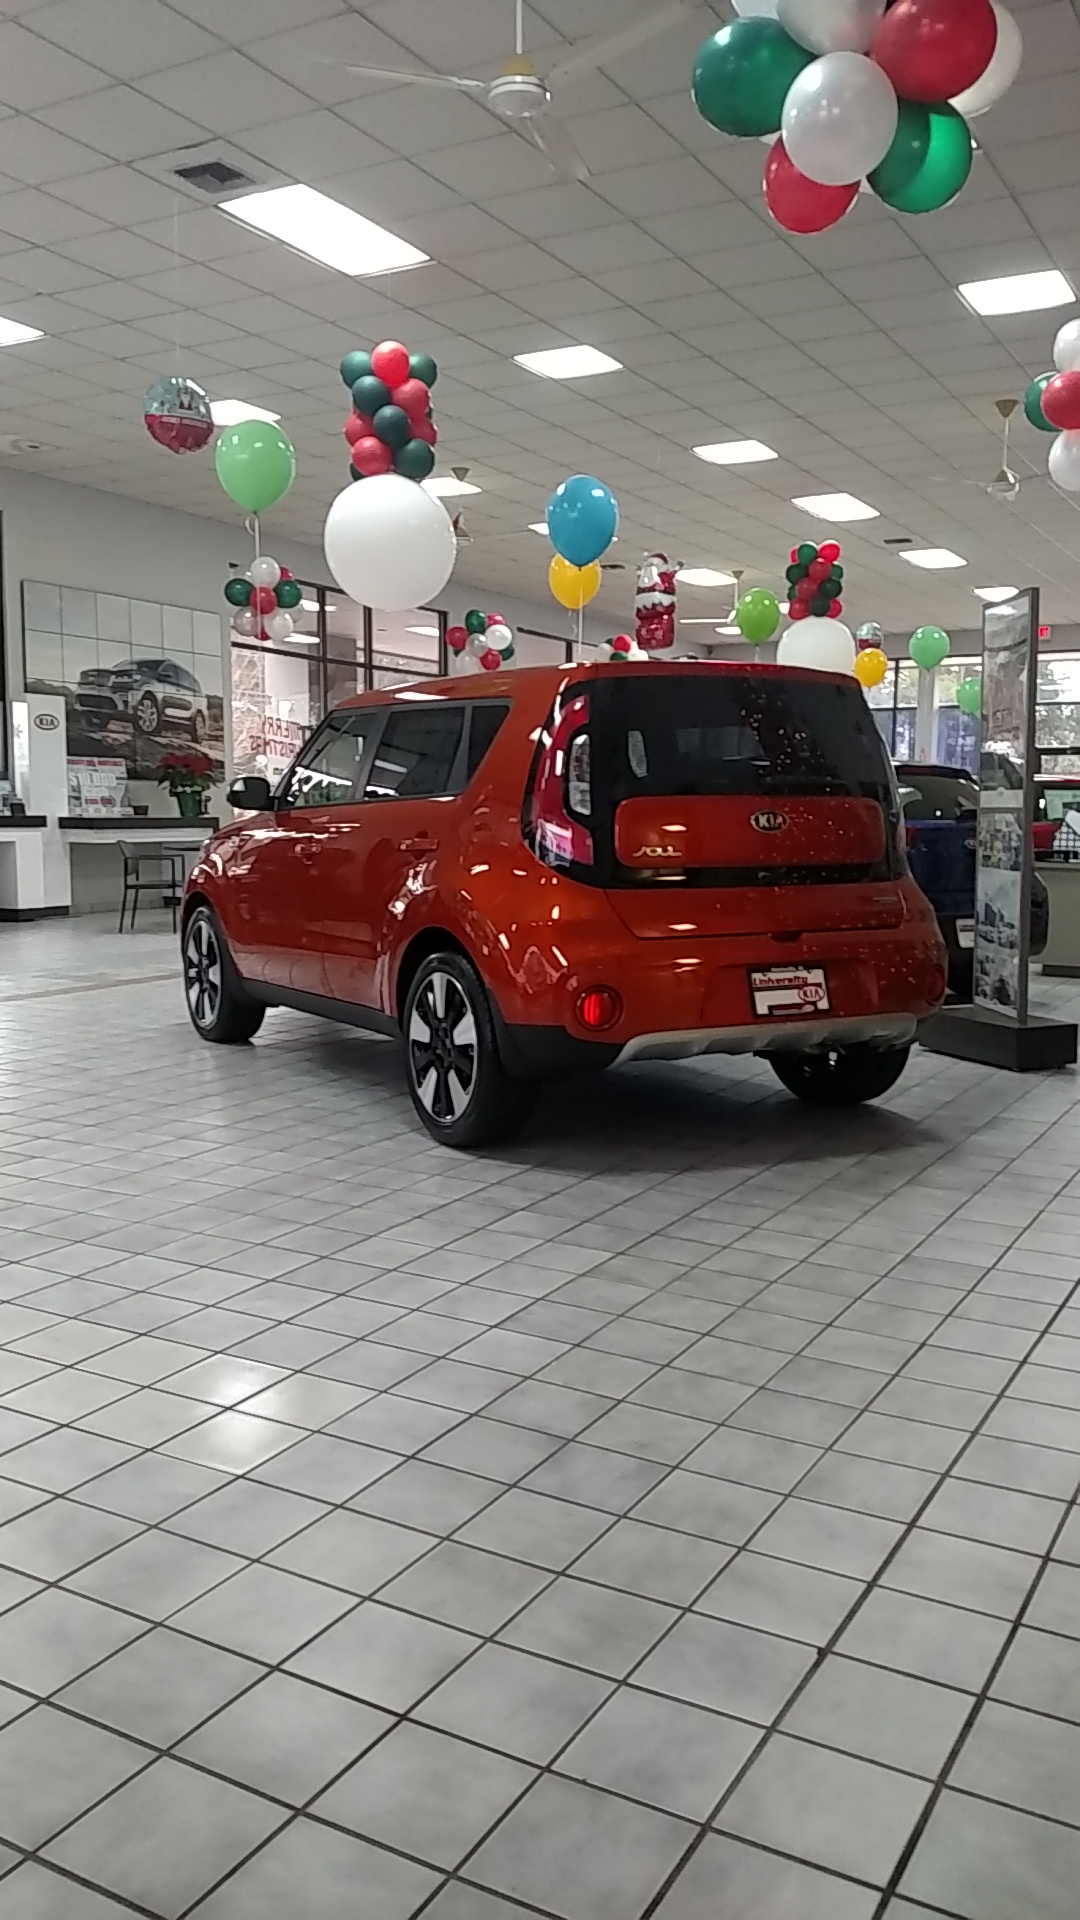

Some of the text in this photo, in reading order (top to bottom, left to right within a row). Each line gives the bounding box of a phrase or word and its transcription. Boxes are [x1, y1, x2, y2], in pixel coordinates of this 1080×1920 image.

[38, 716, 57, 728] KIA
[758, 813, 785, 828] KIA
[802, 987, 822, 999] KIA
